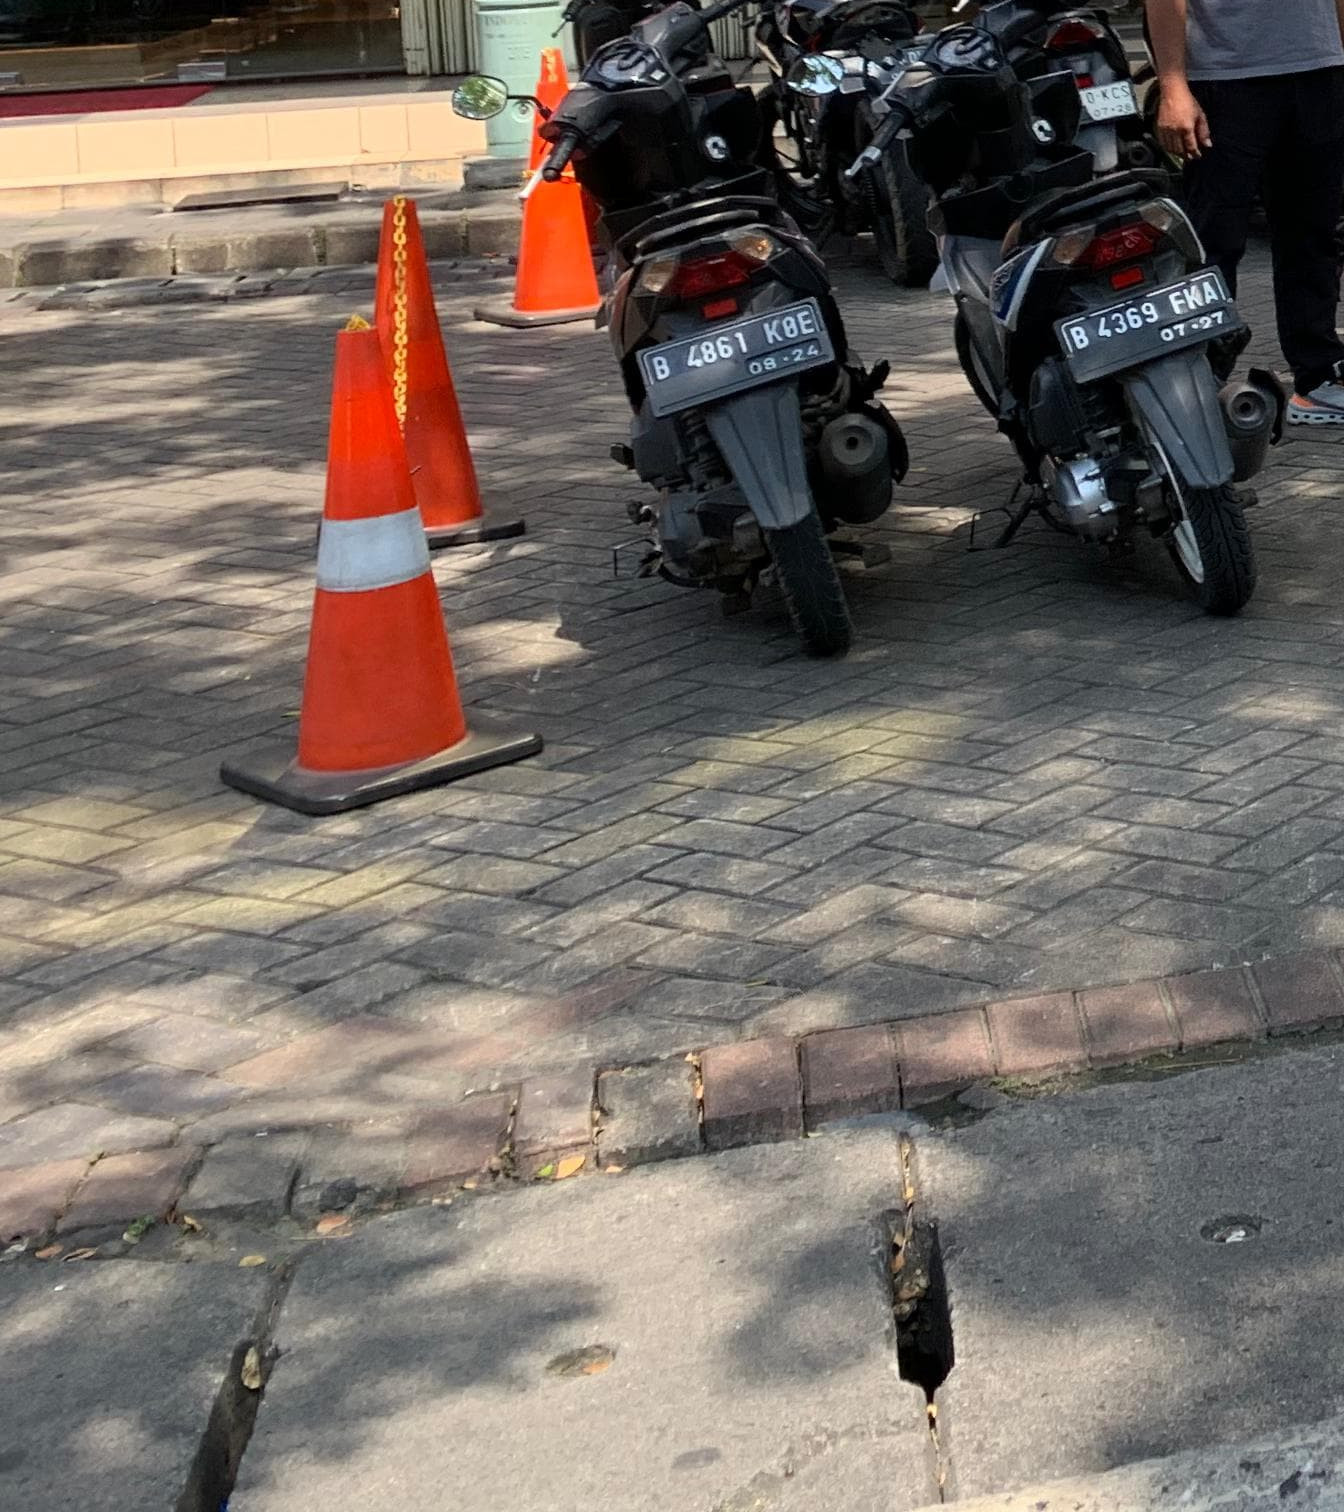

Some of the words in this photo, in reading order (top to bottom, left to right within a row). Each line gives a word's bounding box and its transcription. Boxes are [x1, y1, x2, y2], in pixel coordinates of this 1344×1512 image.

[1070, 326, 1089, 350] B
[1098, 302, 1159, 338] 4369
[652, 356, 670, 380] B
[687, 332, 748, 368] 4861
